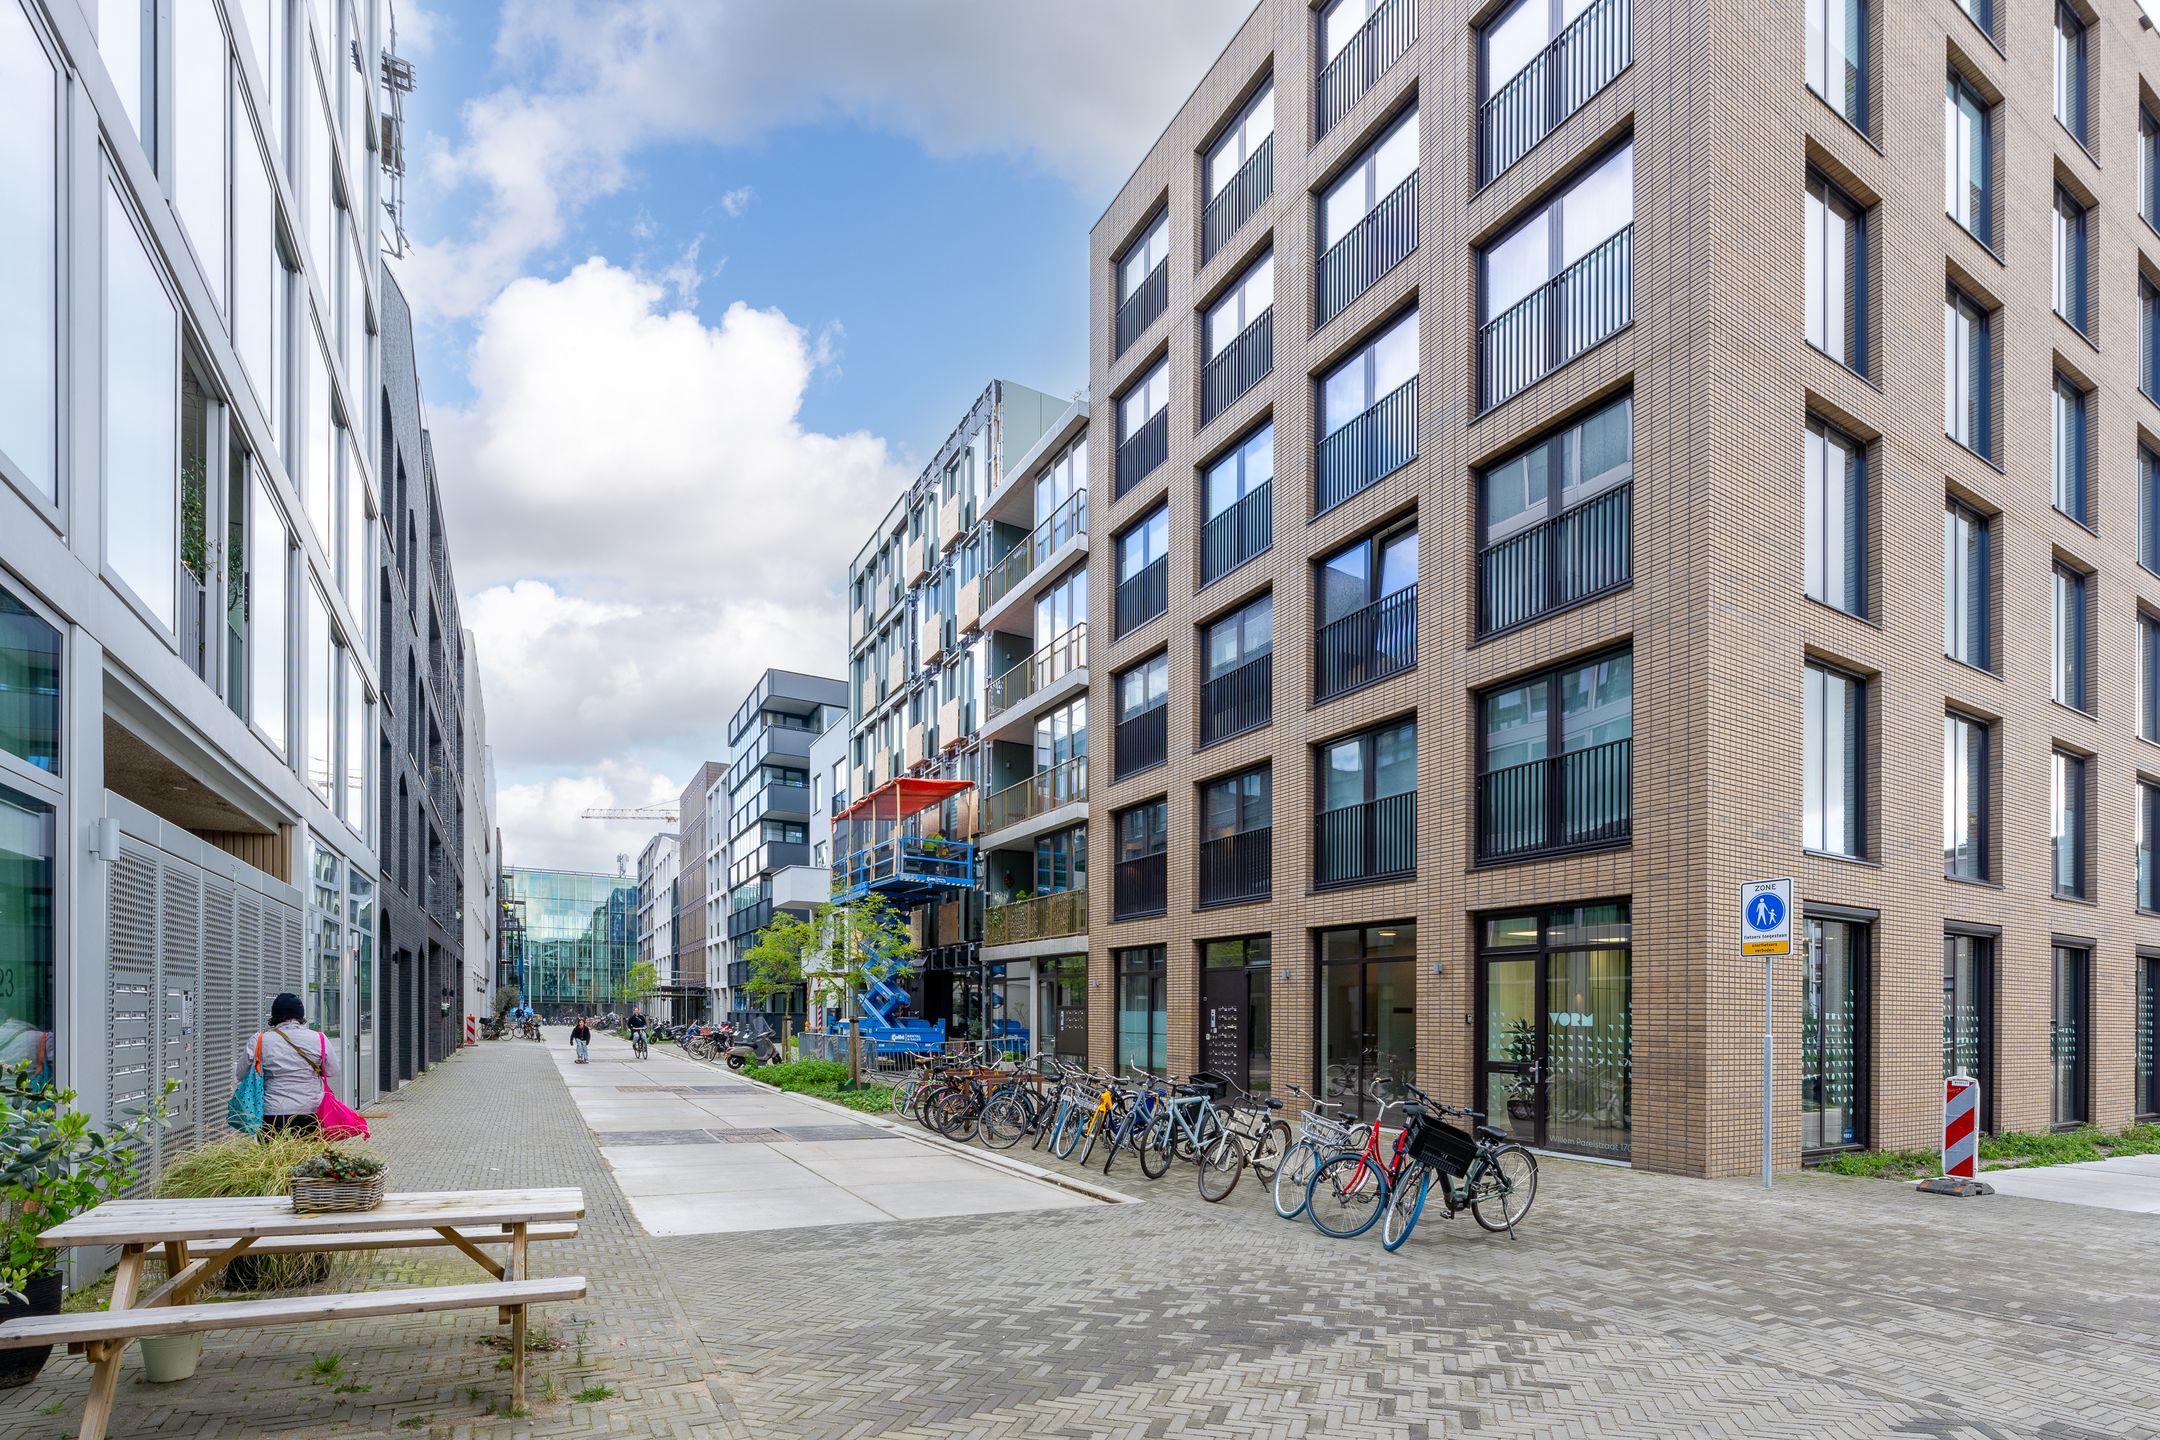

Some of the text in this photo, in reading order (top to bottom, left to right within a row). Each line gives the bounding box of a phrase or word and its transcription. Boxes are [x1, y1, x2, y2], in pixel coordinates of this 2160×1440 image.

[1755, 884, 1777, 892] ZONE
[1549, 1012, 1593, 1027] VORM
[1549, 1135, 1576, 1145] Willem
[1576, 1138, 1619, 1151] Parelstraat
